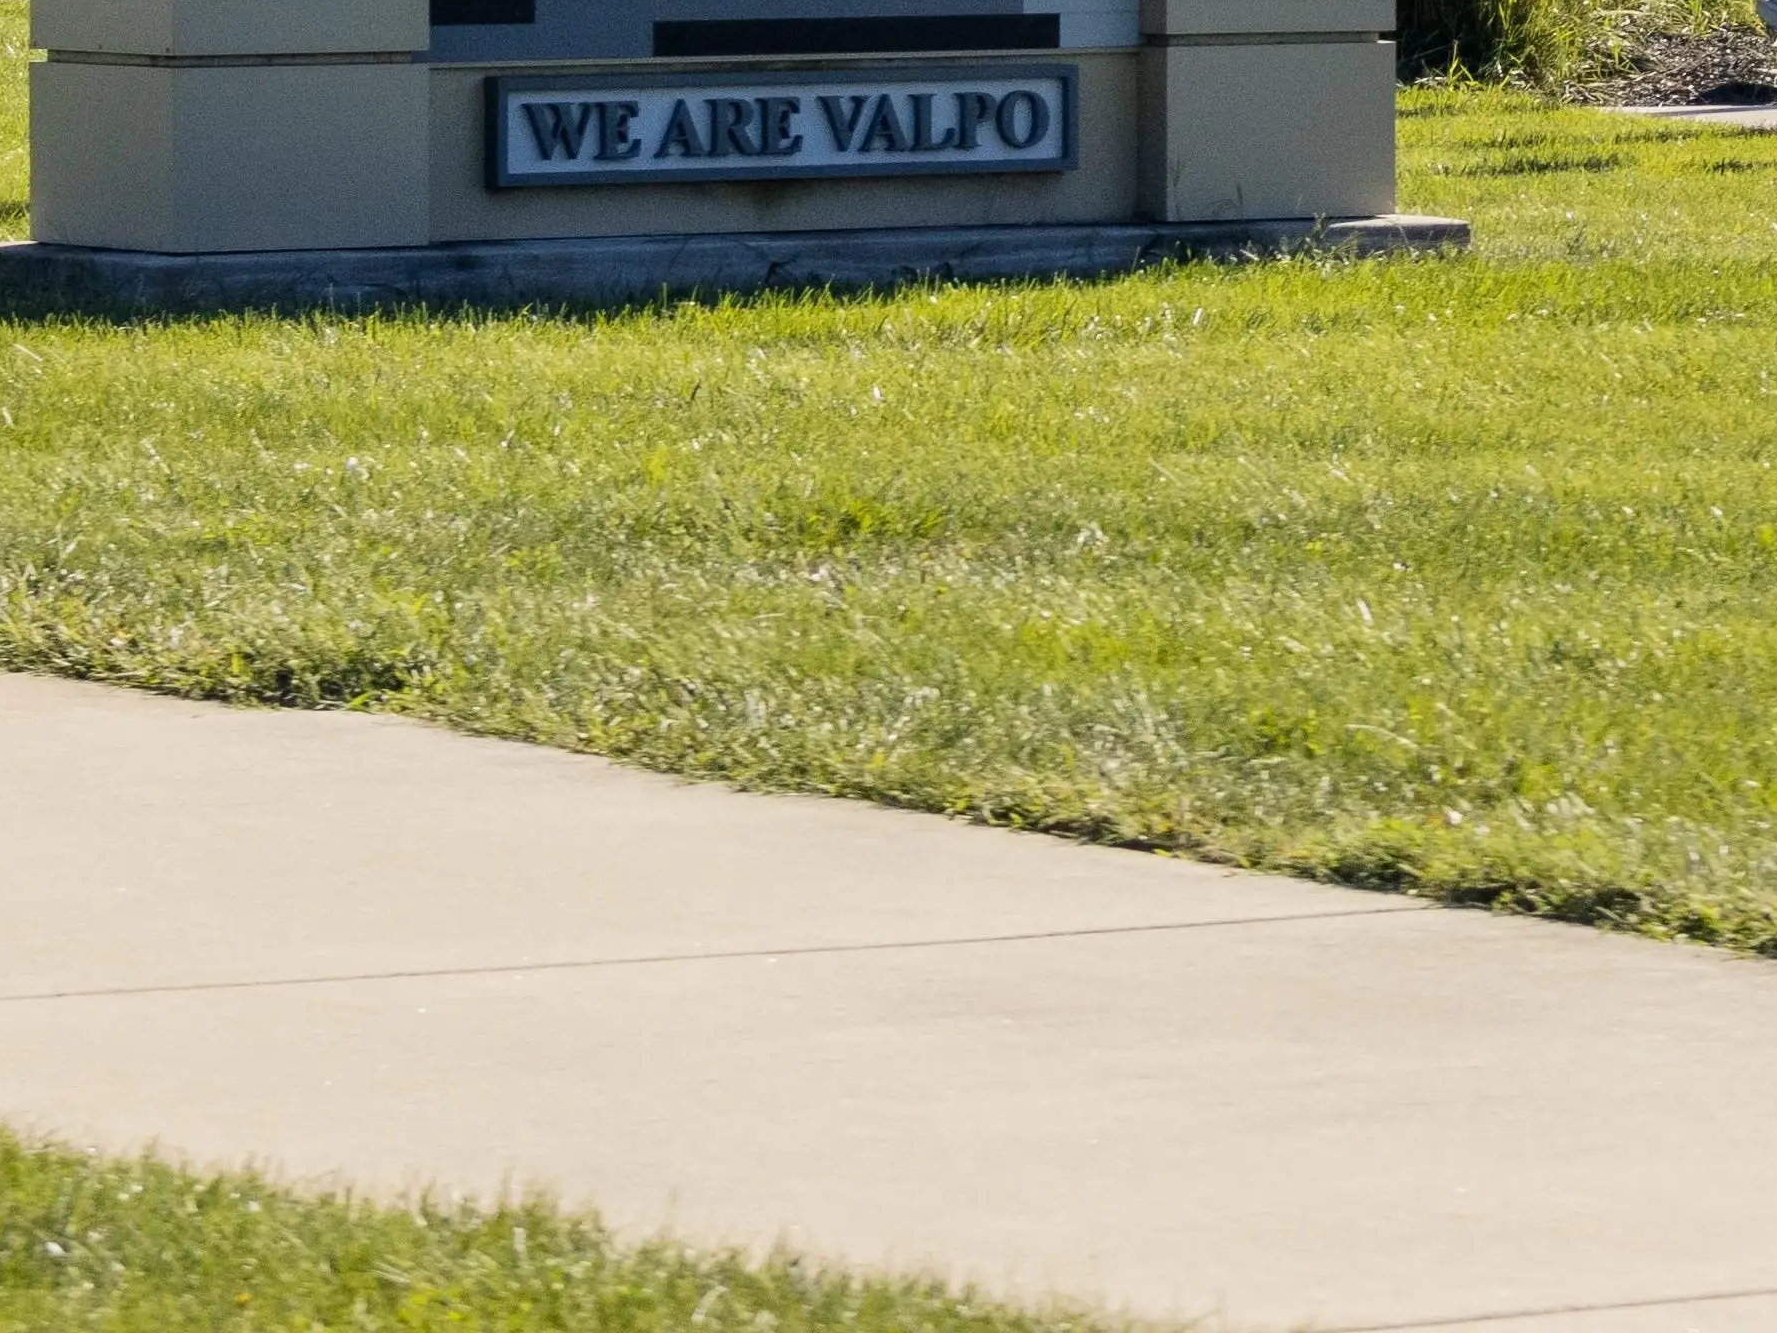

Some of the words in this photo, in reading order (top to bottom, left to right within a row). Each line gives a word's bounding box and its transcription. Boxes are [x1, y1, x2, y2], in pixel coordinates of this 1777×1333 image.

[521, 100, 642, 162] WE
[654, 95, 803, 159] ARE
[816, 89, 1051, 153] VALPO
